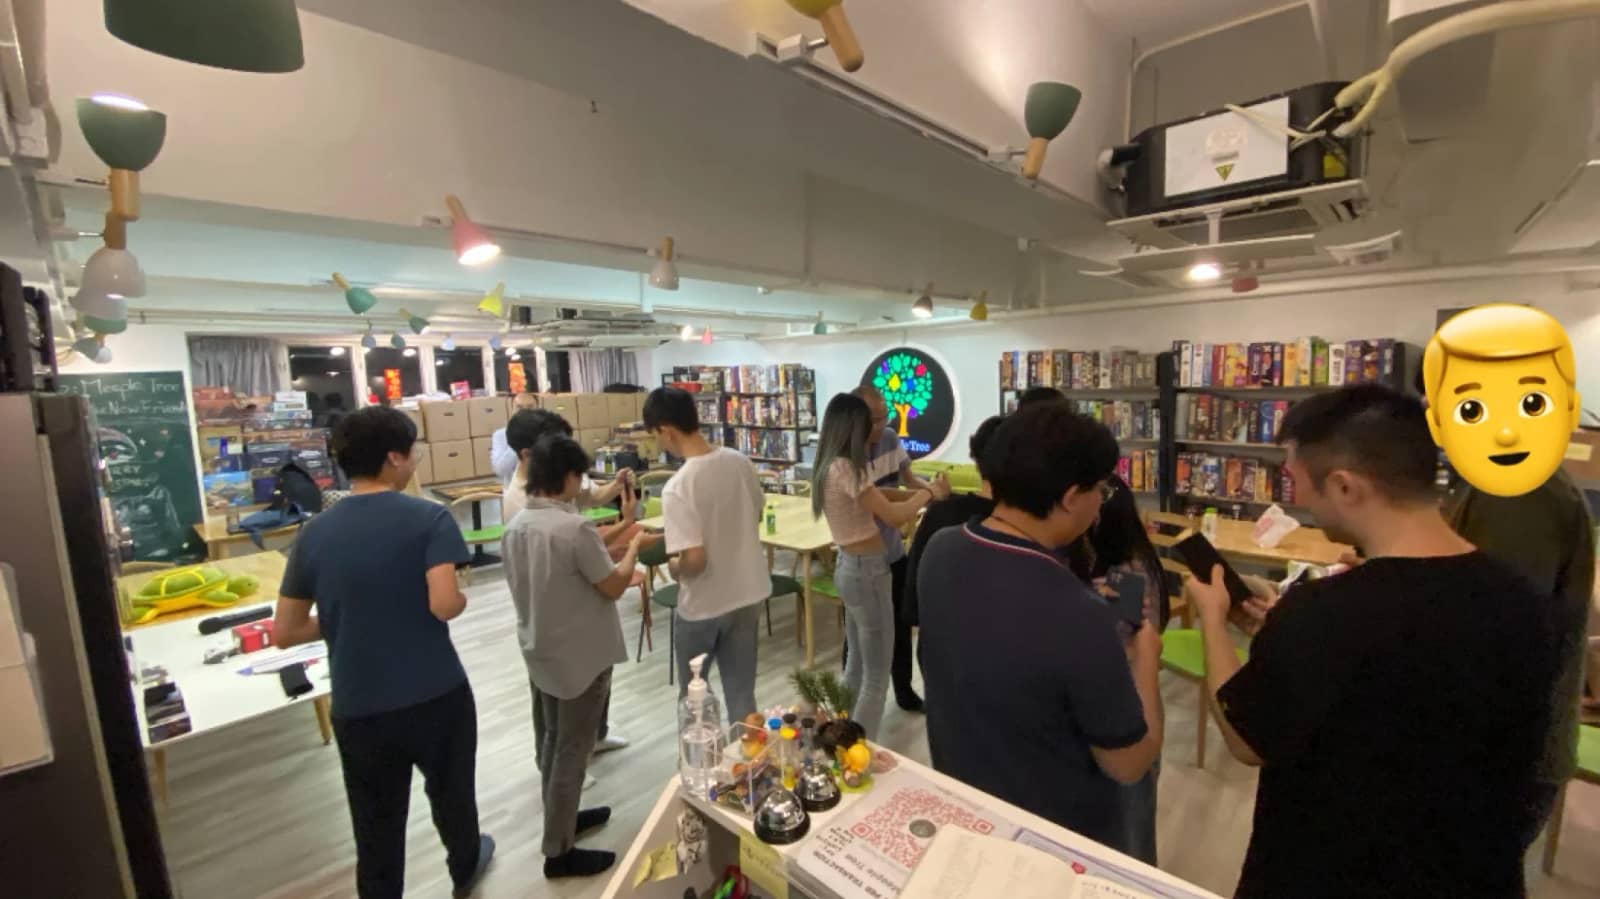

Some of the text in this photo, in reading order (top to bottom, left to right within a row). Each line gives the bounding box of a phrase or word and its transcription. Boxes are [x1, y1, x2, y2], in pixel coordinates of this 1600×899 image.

[80, 378, 143, 401] Meeple
[151, 377, 180, 393] Tree
[108, 400, 139, 415] New
[909, 440, 931, 451] Tree
[813, 849, 864, 888] TRANSACTION
